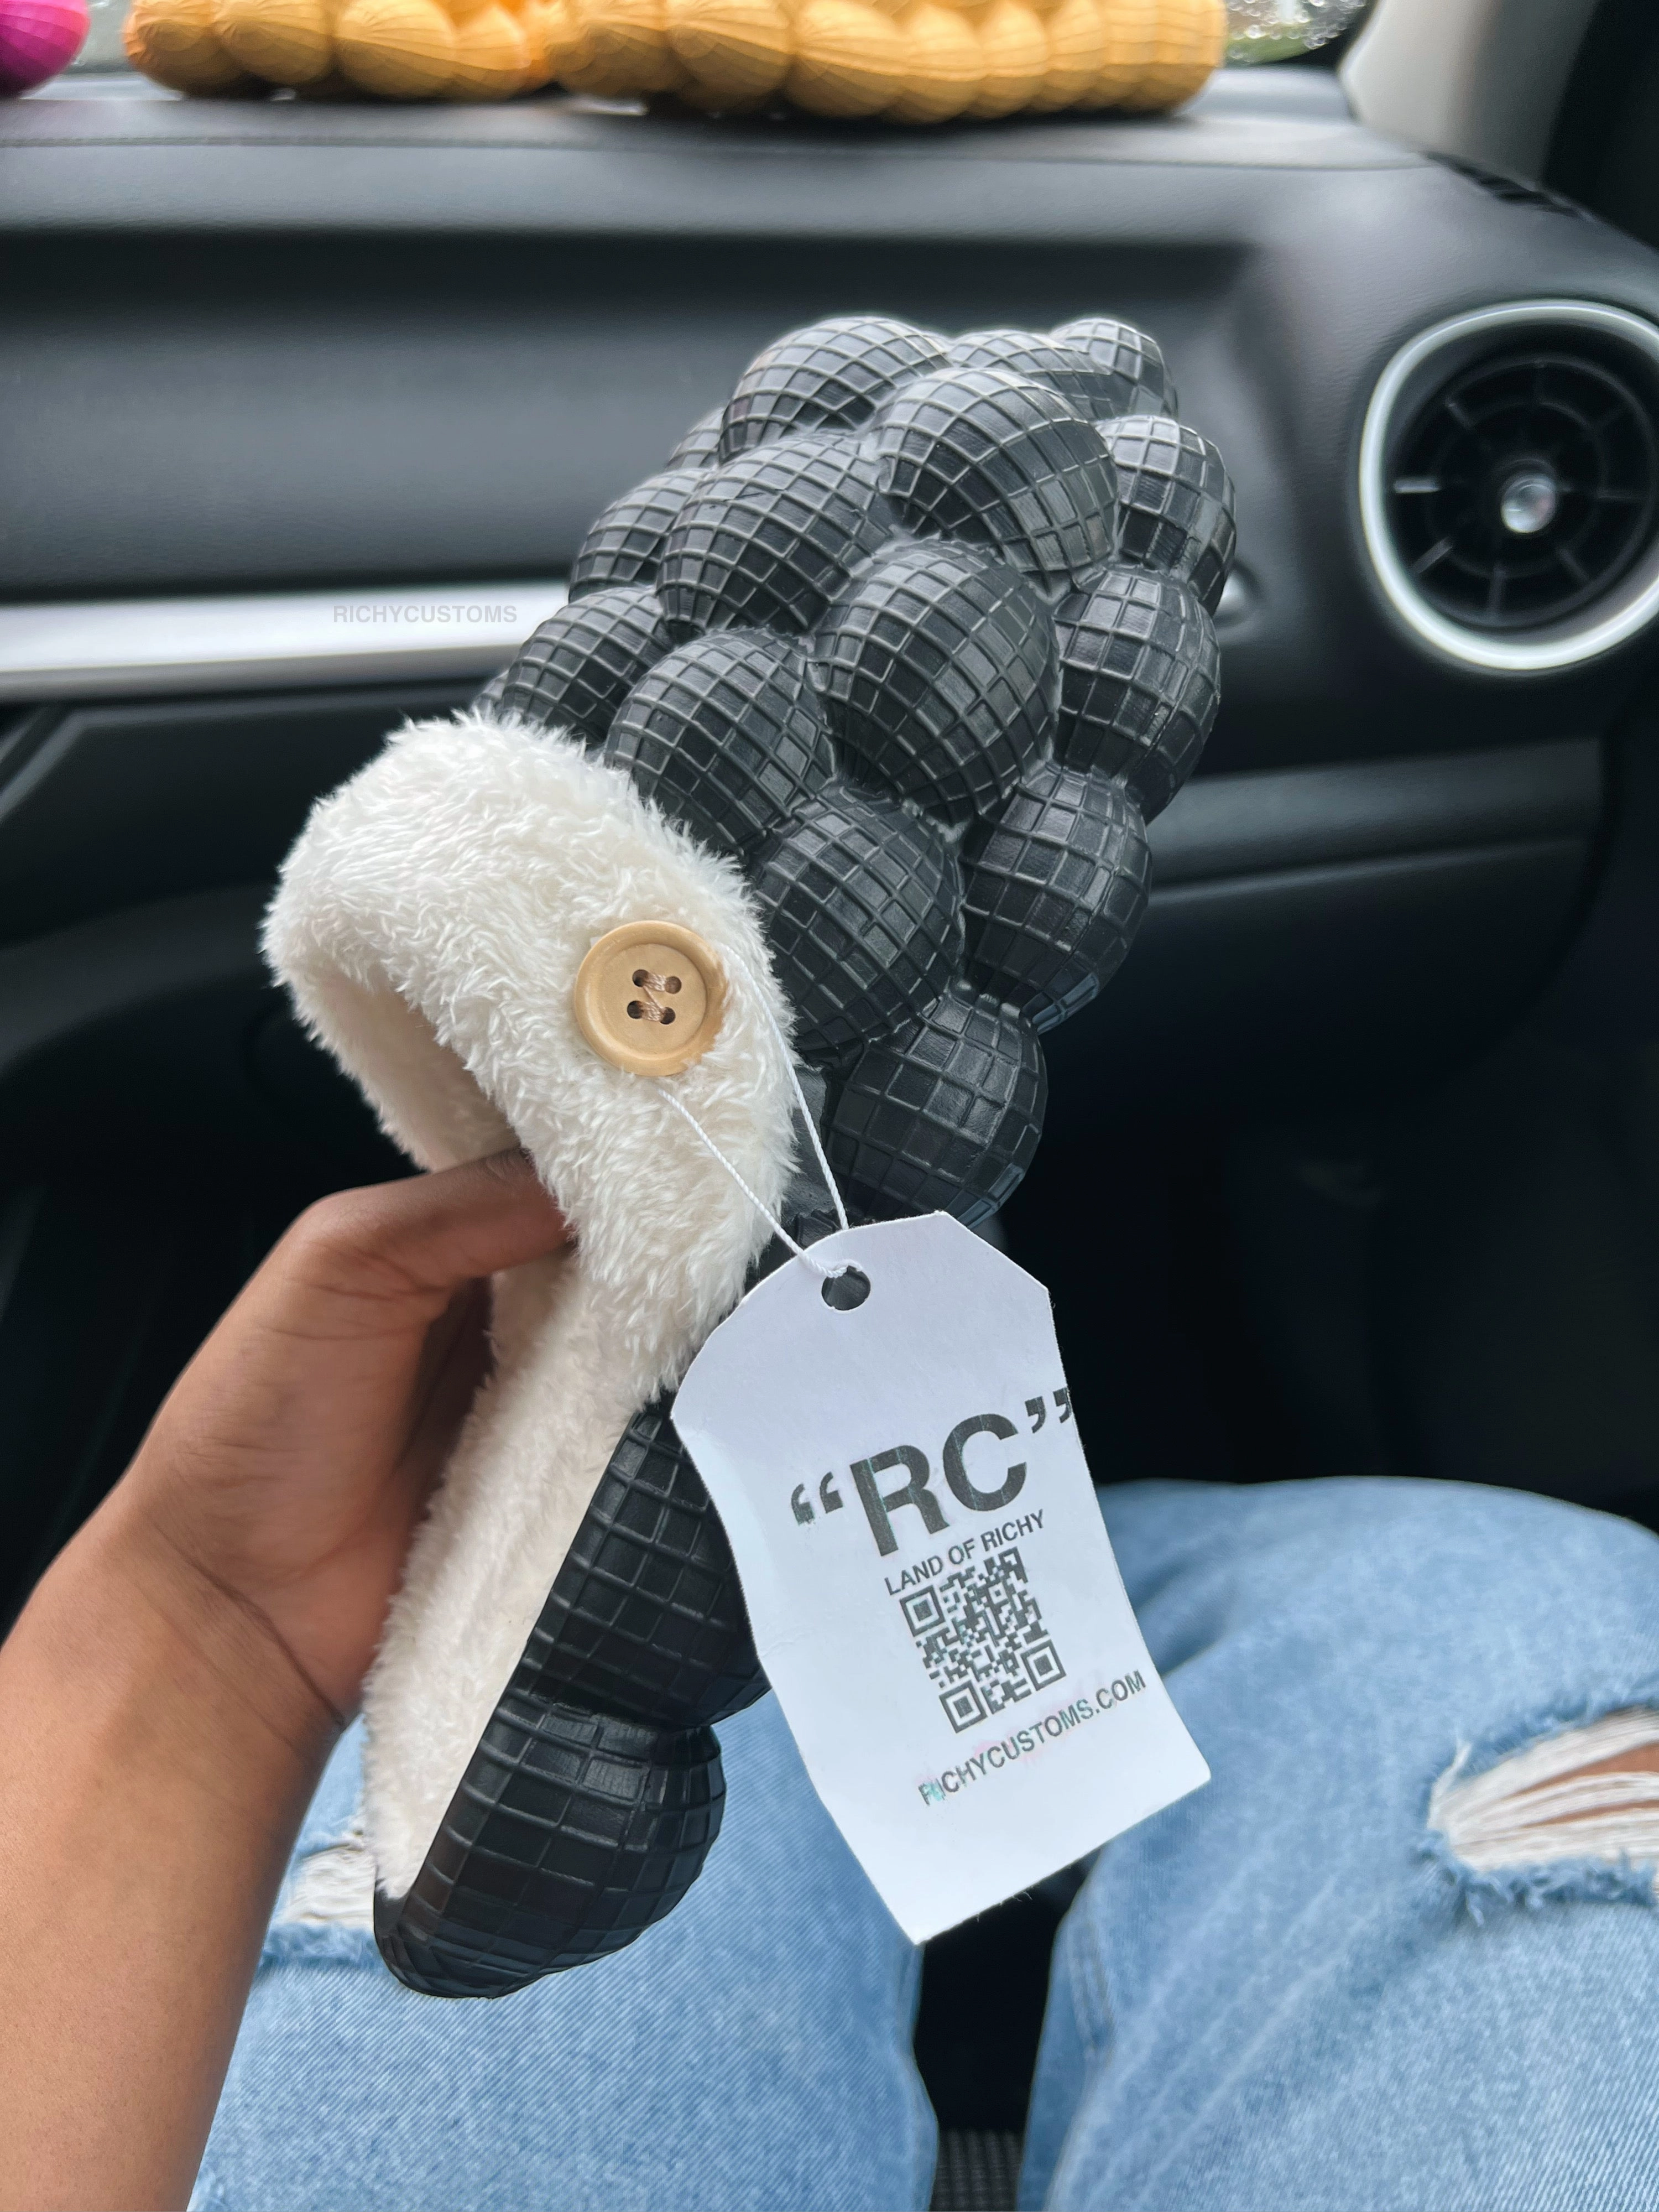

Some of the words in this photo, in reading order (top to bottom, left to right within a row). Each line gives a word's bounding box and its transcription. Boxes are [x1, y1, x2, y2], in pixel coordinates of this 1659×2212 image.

[884, 1555, 943, 1596] LAND
[948, 1538, 975, 1565] OF
[980, 1509, 1044, 1551] RICHY
